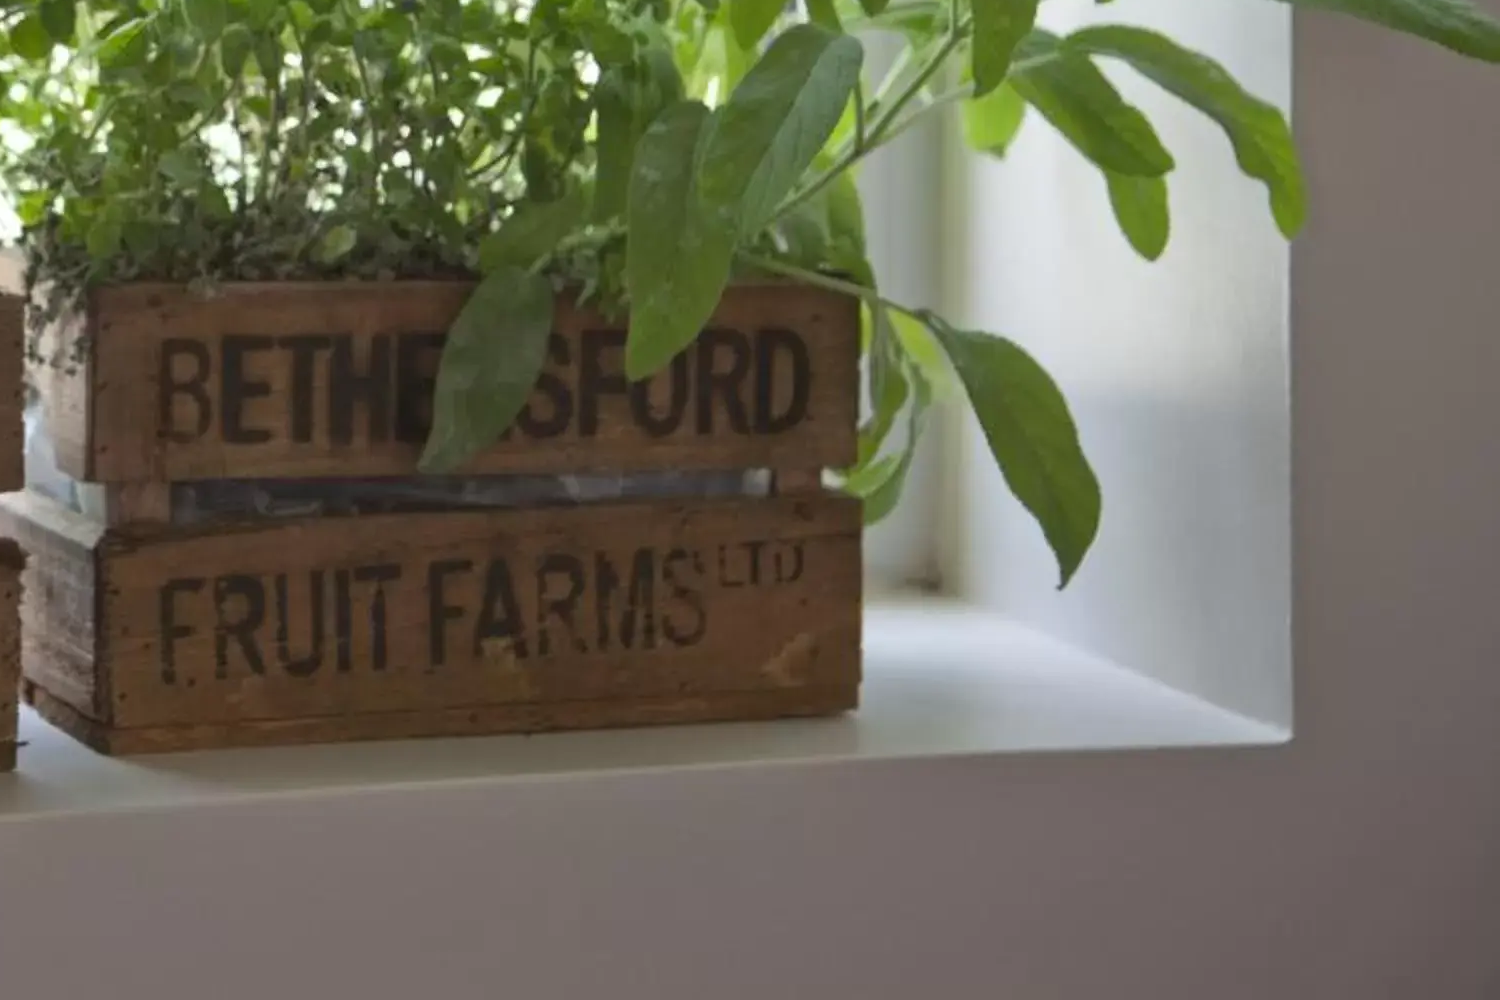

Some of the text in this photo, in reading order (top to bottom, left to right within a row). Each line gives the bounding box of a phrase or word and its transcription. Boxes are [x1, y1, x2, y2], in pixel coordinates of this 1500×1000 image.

[158, 328, 811, 443] BETHESFORD
[158, 540, 805, 687] FRUIT FARMS LTD
